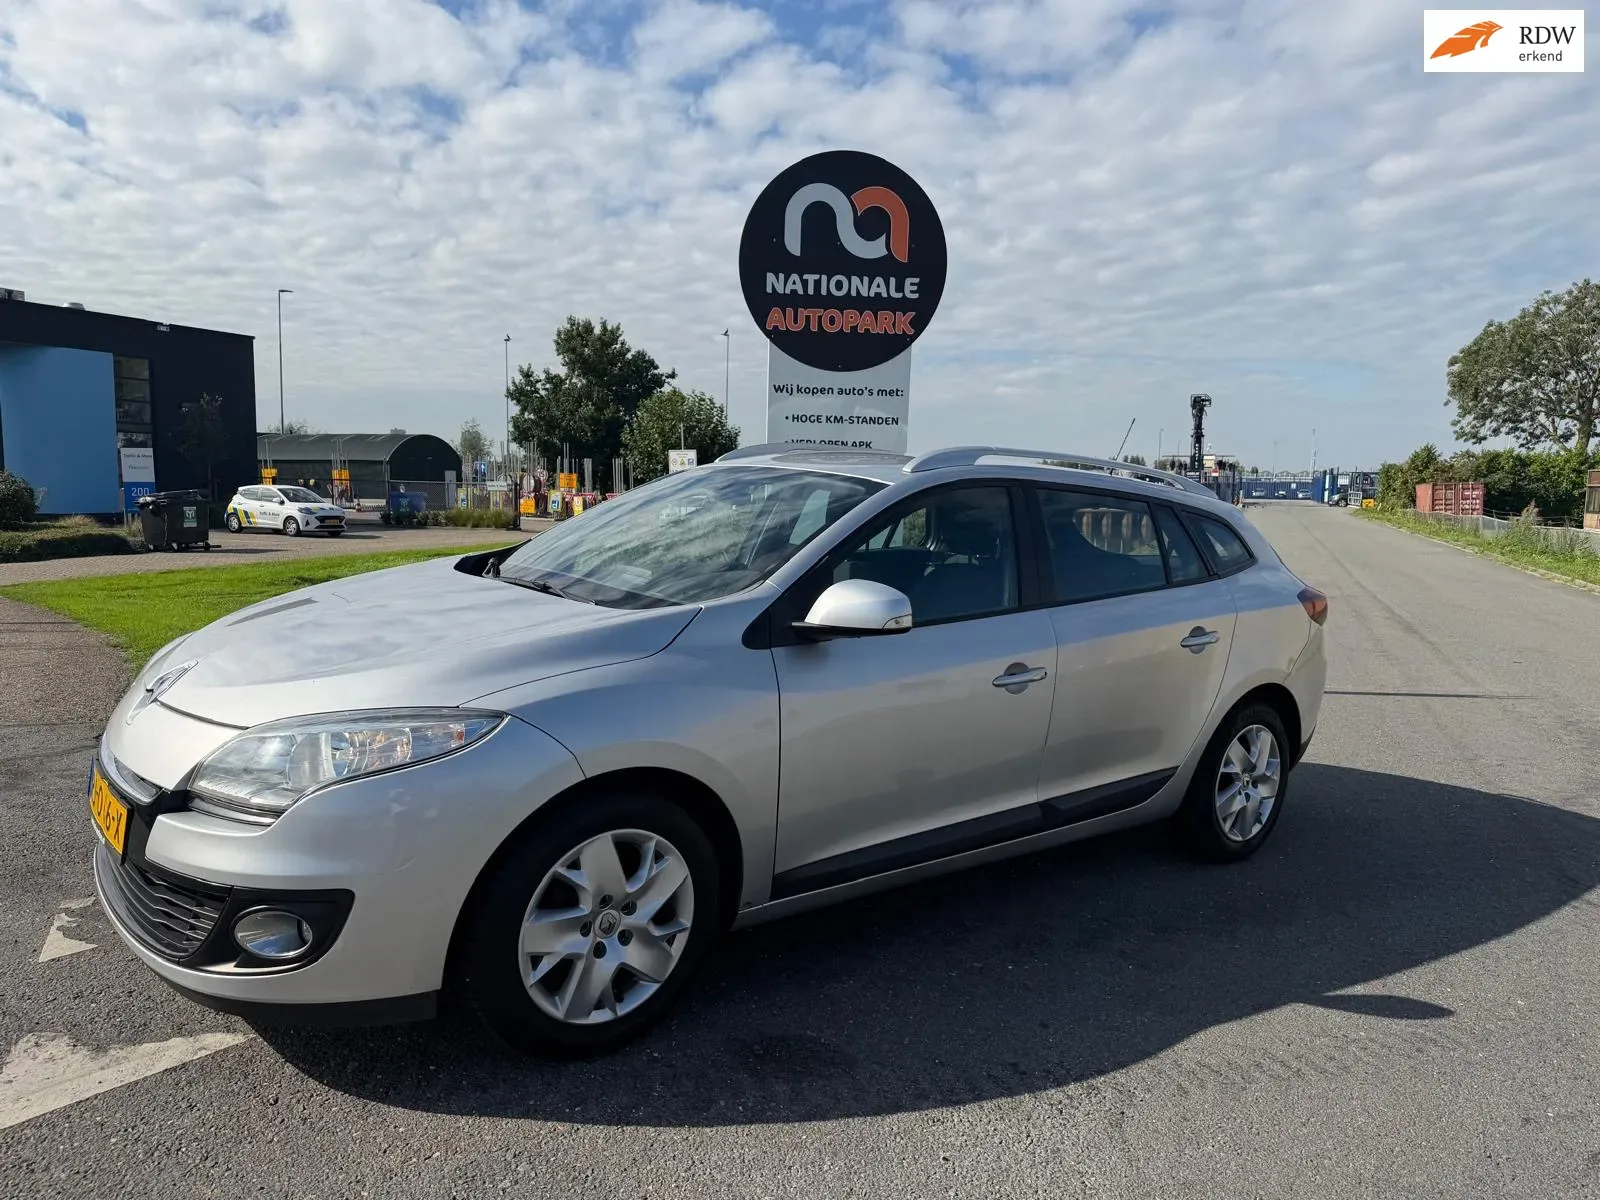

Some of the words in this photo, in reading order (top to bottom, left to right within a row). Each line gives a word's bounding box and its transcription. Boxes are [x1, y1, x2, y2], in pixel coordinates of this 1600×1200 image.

[766, 272, 920, 299] NATIONALE
[766, 307, 916, 335] AUTOPARK
[773, 384, 794, 396] Wij
[796, 384, 834, 397] kopen
[837, 386, 874, 397] auto's
[877, 387, 904, 397] met:
[791, 414, 823, 423] HOGE
[825, 415, 899, 426] KM-STANDEN
[851, 441, 873, 449] APK
[131, 487, 150, 497] 200
